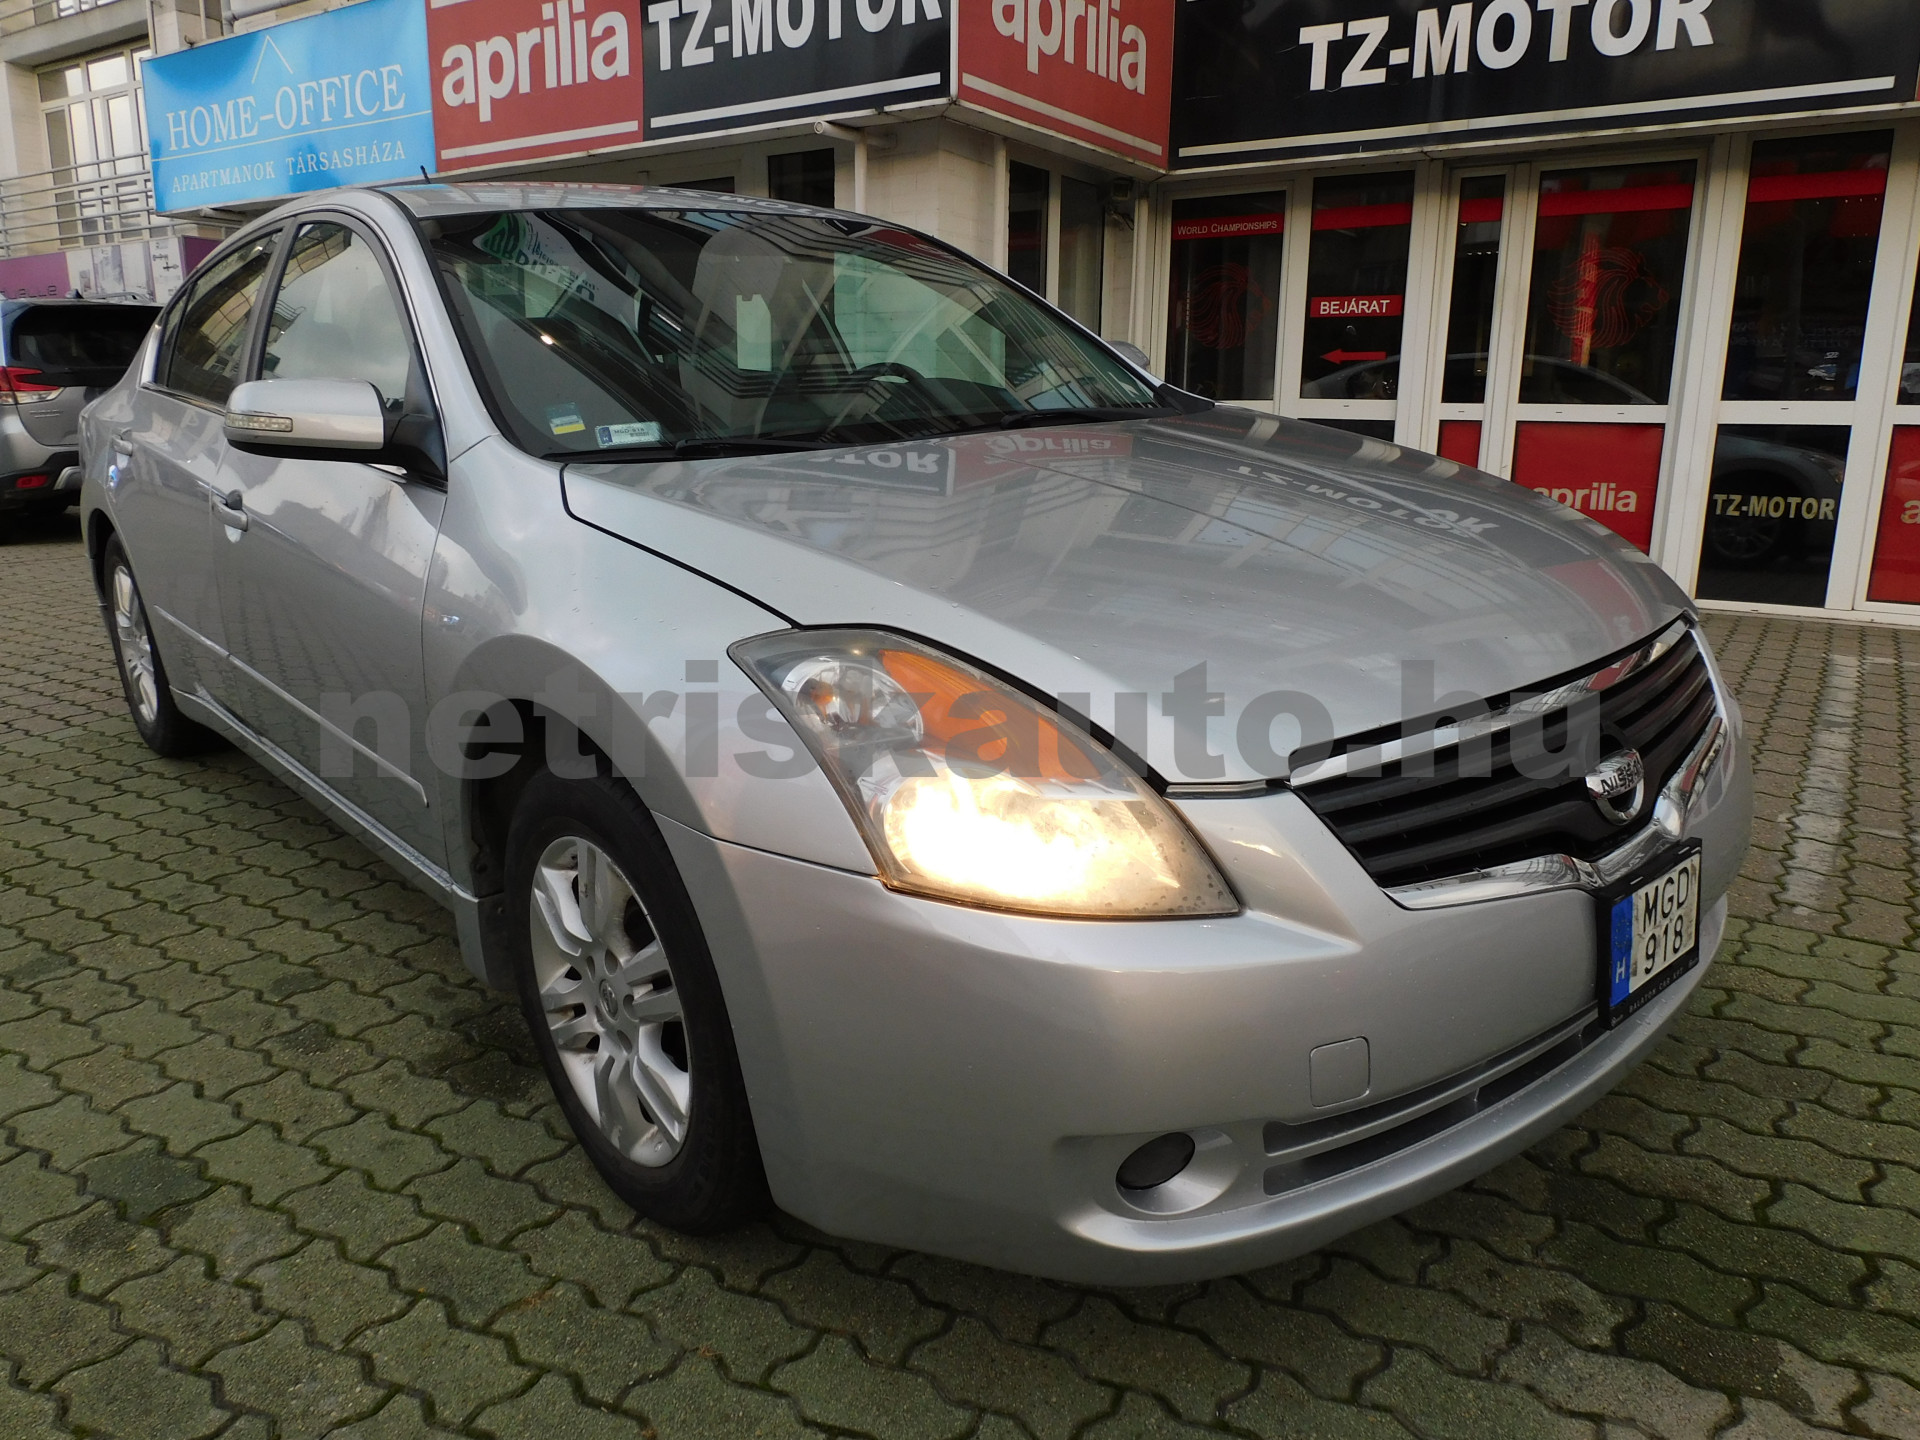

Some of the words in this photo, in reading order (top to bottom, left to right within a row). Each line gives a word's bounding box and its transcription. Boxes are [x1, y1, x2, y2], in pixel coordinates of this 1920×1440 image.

[441, 0, 630, 123] aprilia
[1299, 0, 1714, 91] TZ-MOTOR
[166, 64, 406, 151] HOME-OFFICE
[172, 160, 276, 194] APARTMANOK
[286, 140, 406, 176] TÁRSASHÁZA
[1177, 225, 1208, 236] WORLD
[1320, 298, 1390, 315] BEJÁRAT
[1713, 494, 1836, 521] TZ-MOTOR
[1643, 866, 1690, 933] MGD
[1615, 956, 1626, 984] H
[1644, 914, 1684, 974] 918
